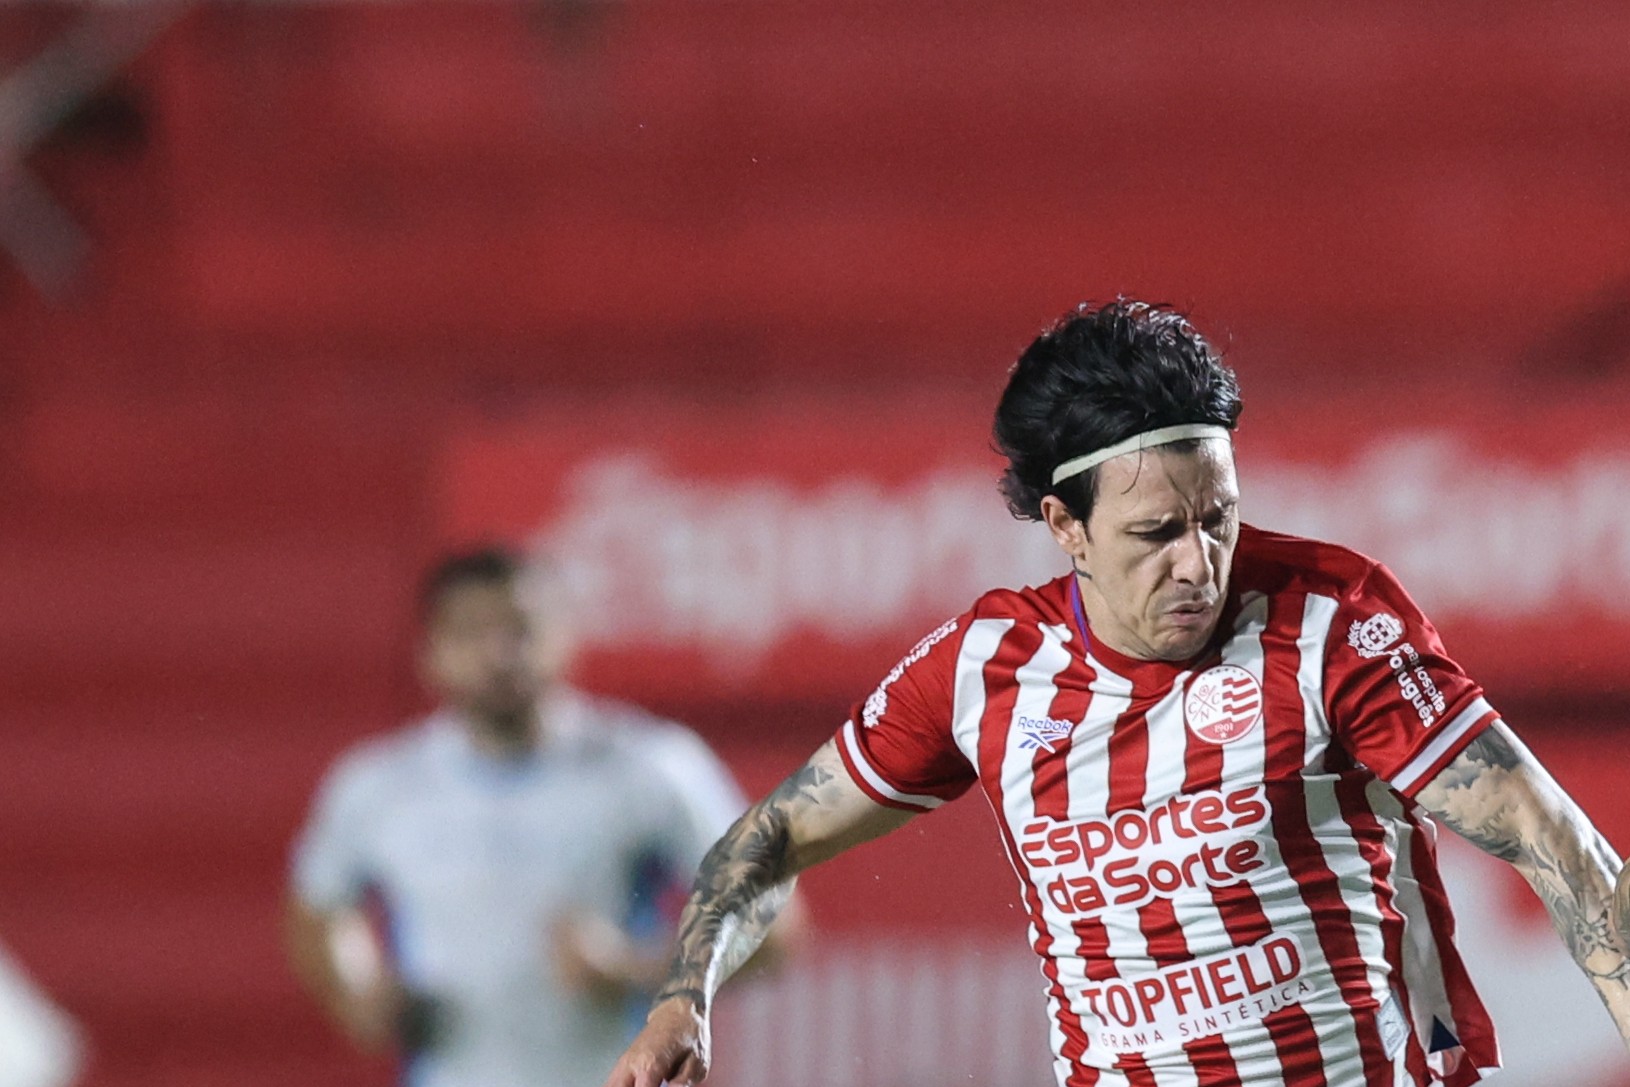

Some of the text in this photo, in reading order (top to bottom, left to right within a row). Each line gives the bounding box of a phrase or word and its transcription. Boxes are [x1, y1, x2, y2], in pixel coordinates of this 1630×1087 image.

[1018, 716, 1071, 733] Reebok
[1021, 785, 1267, 872] Esportes
[1046, 839, 1267, 914] da Sorte
[1081, 937, 1301, 1028] TOPFIELD
[1101, 980, 1311, 1049] GRAMA SINTÉTICA
